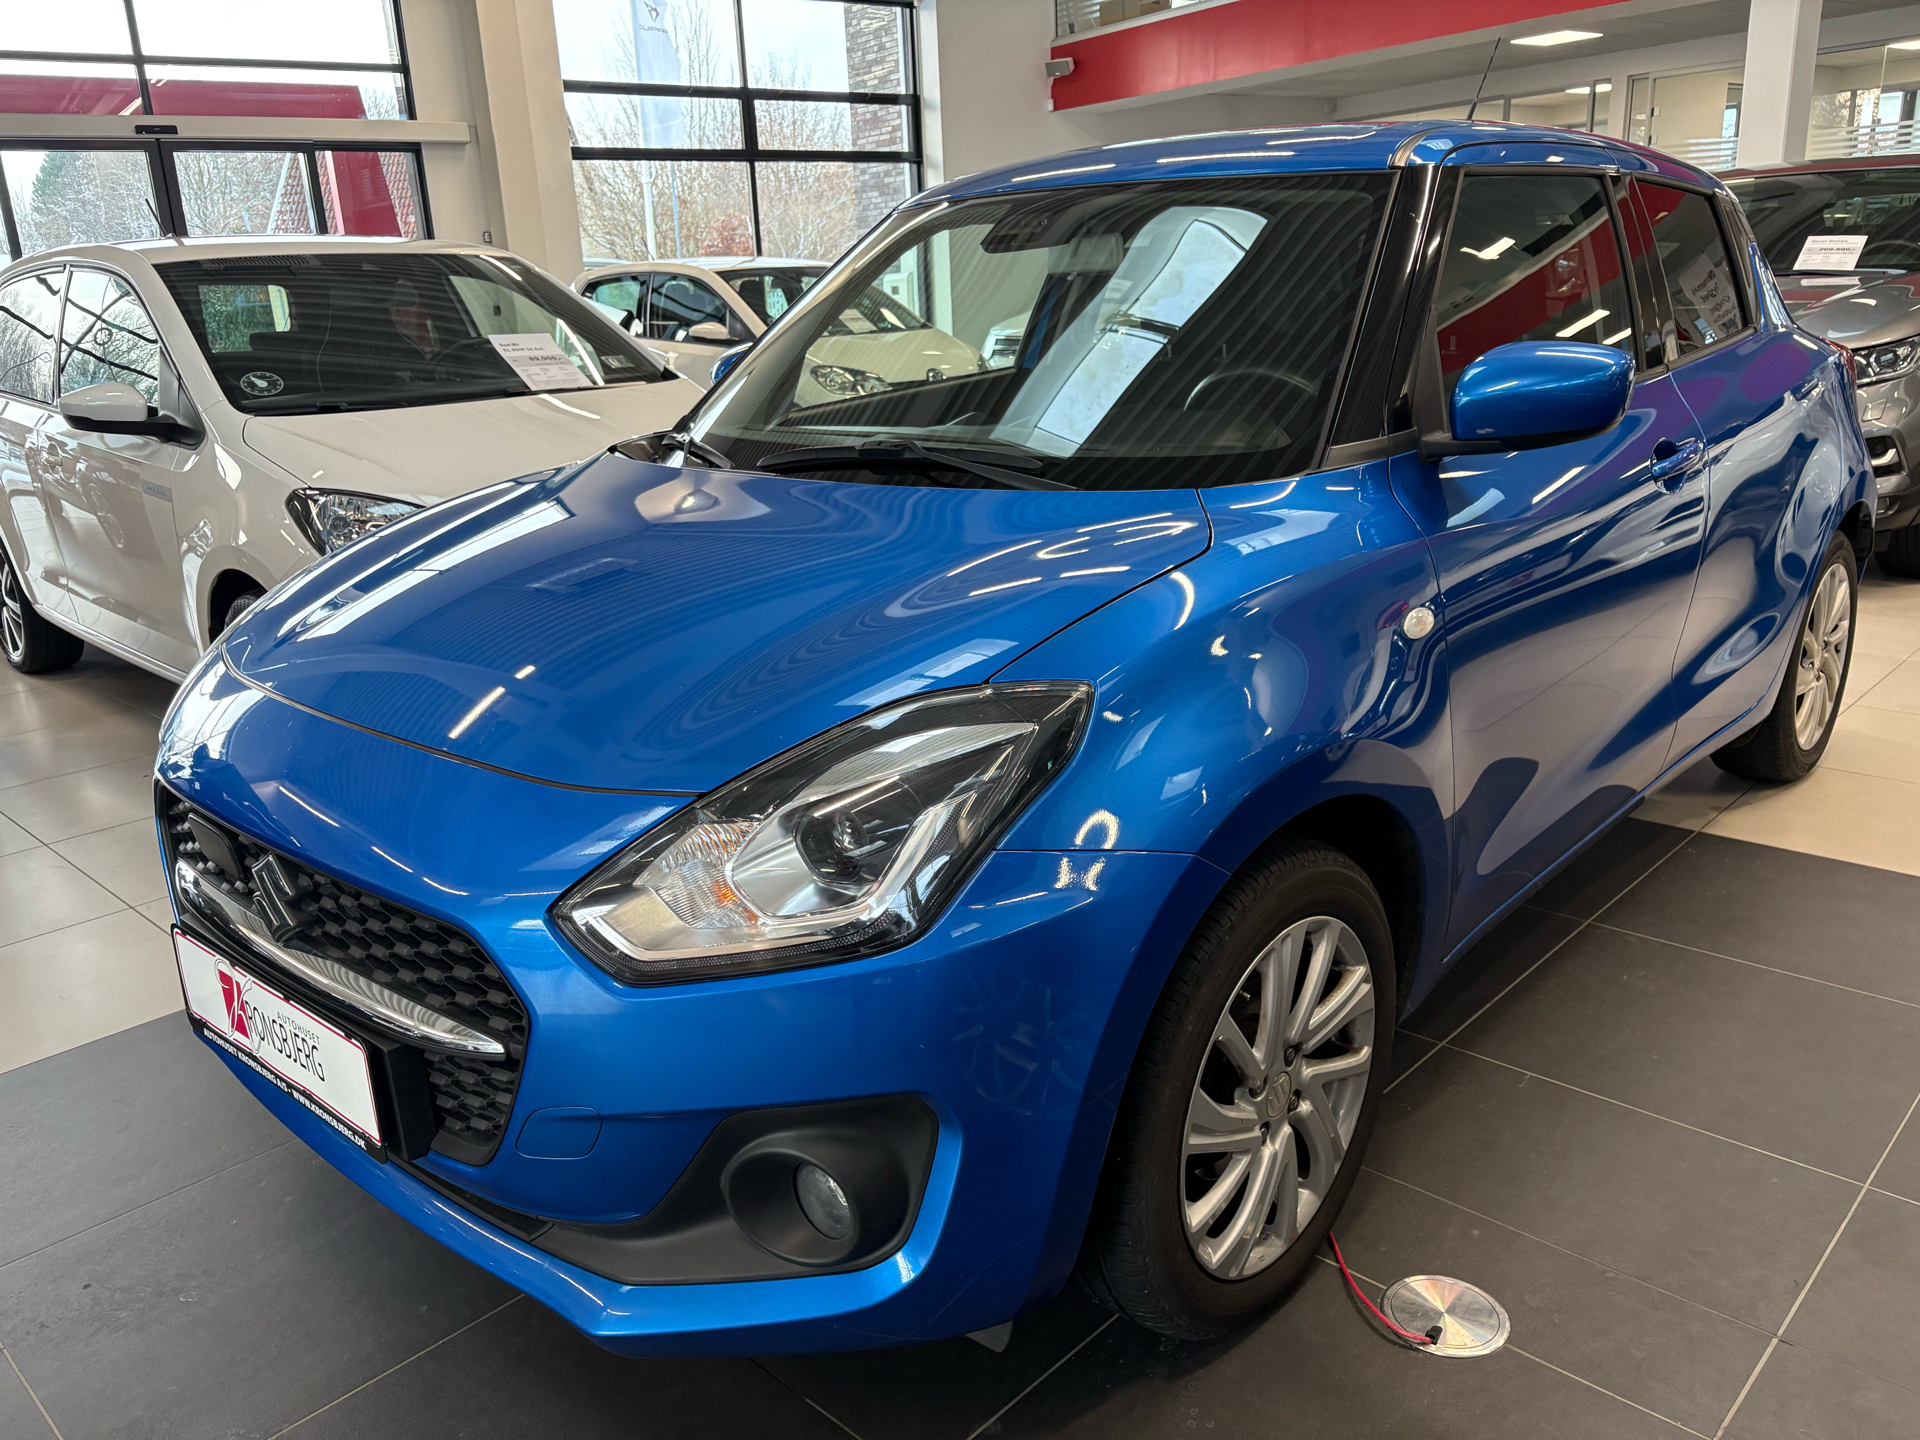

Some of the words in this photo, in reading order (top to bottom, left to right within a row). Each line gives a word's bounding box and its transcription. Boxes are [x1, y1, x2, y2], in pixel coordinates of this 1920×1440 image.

[277, 1011, 321, 1046] AUTOHUSET
[203, 1027, 238, 1057] AUTOHUSET
[237, 1050, 277, 1084] KRONSBJERG
[291, 1088, 368, 1151] WWW.KRONSBJERG.DK
